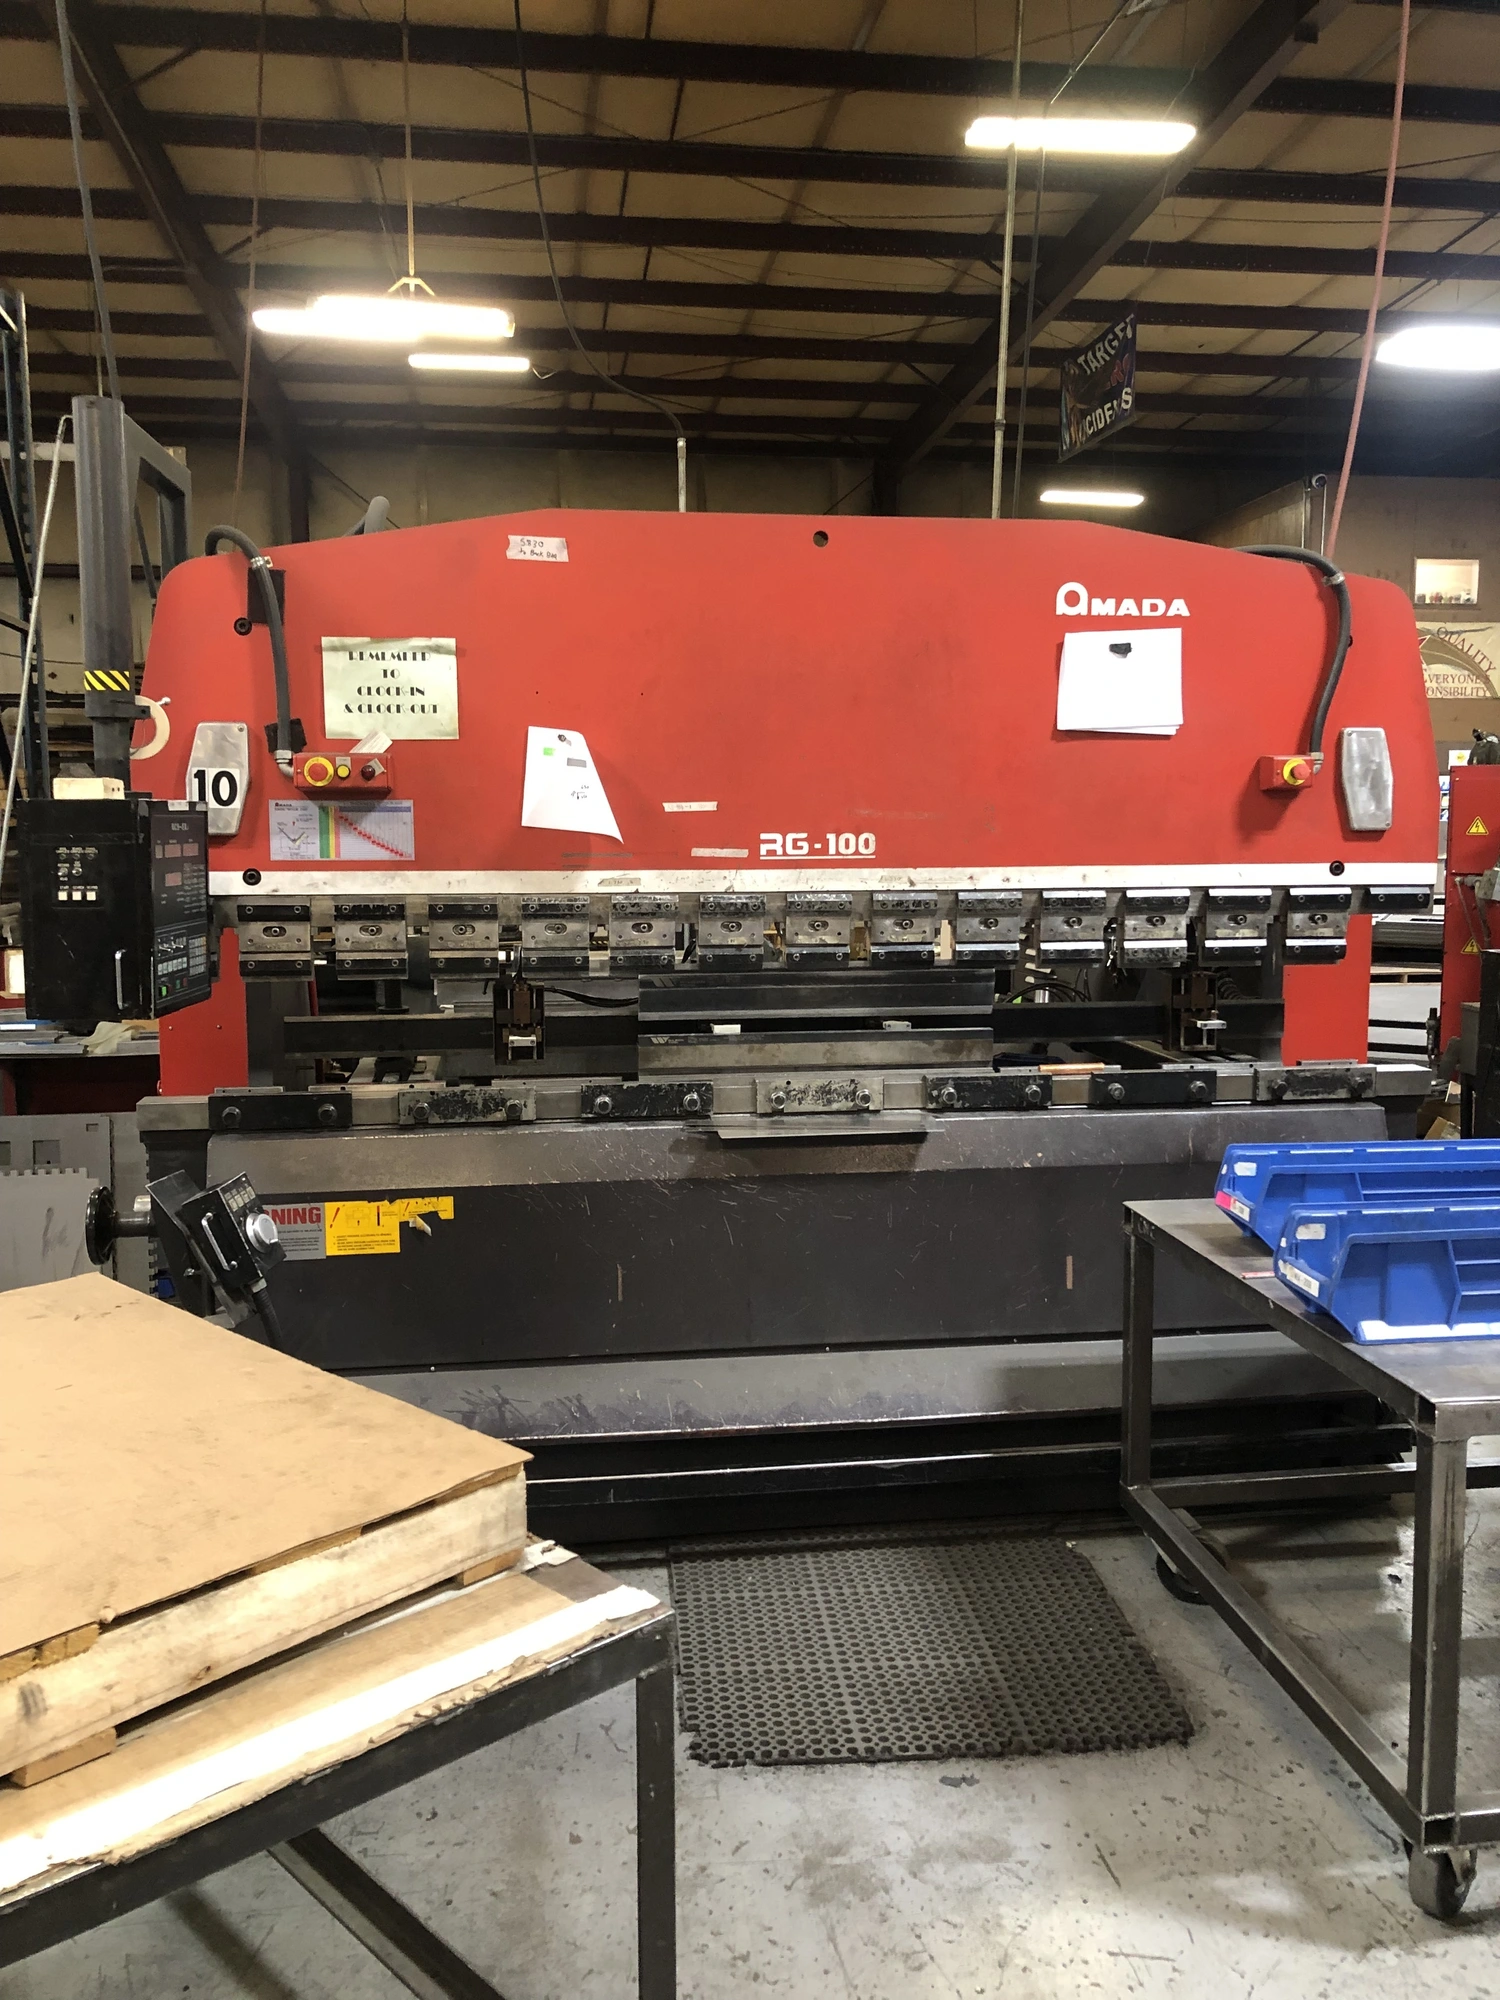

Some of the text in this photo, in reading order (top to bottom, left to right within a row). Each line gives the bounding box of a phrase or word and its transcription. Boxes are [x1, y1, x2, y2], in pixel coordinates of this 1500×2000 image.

[1055, 581, 1191, 617] AMADA
[348, 651, 432, 661] REMEMBER
[1437, 626, 1497, 673] QUALITY
[381, 668, 400, 679] TO
[356, 685, 426, 697] CLOCK-IN
[343, 702, 439, 714] & CLOCK-OUT
[193, 769, 238, 807] 10
[759, 832, 876, 856] RG-100
[263, 1207, 322, 1225] NING
